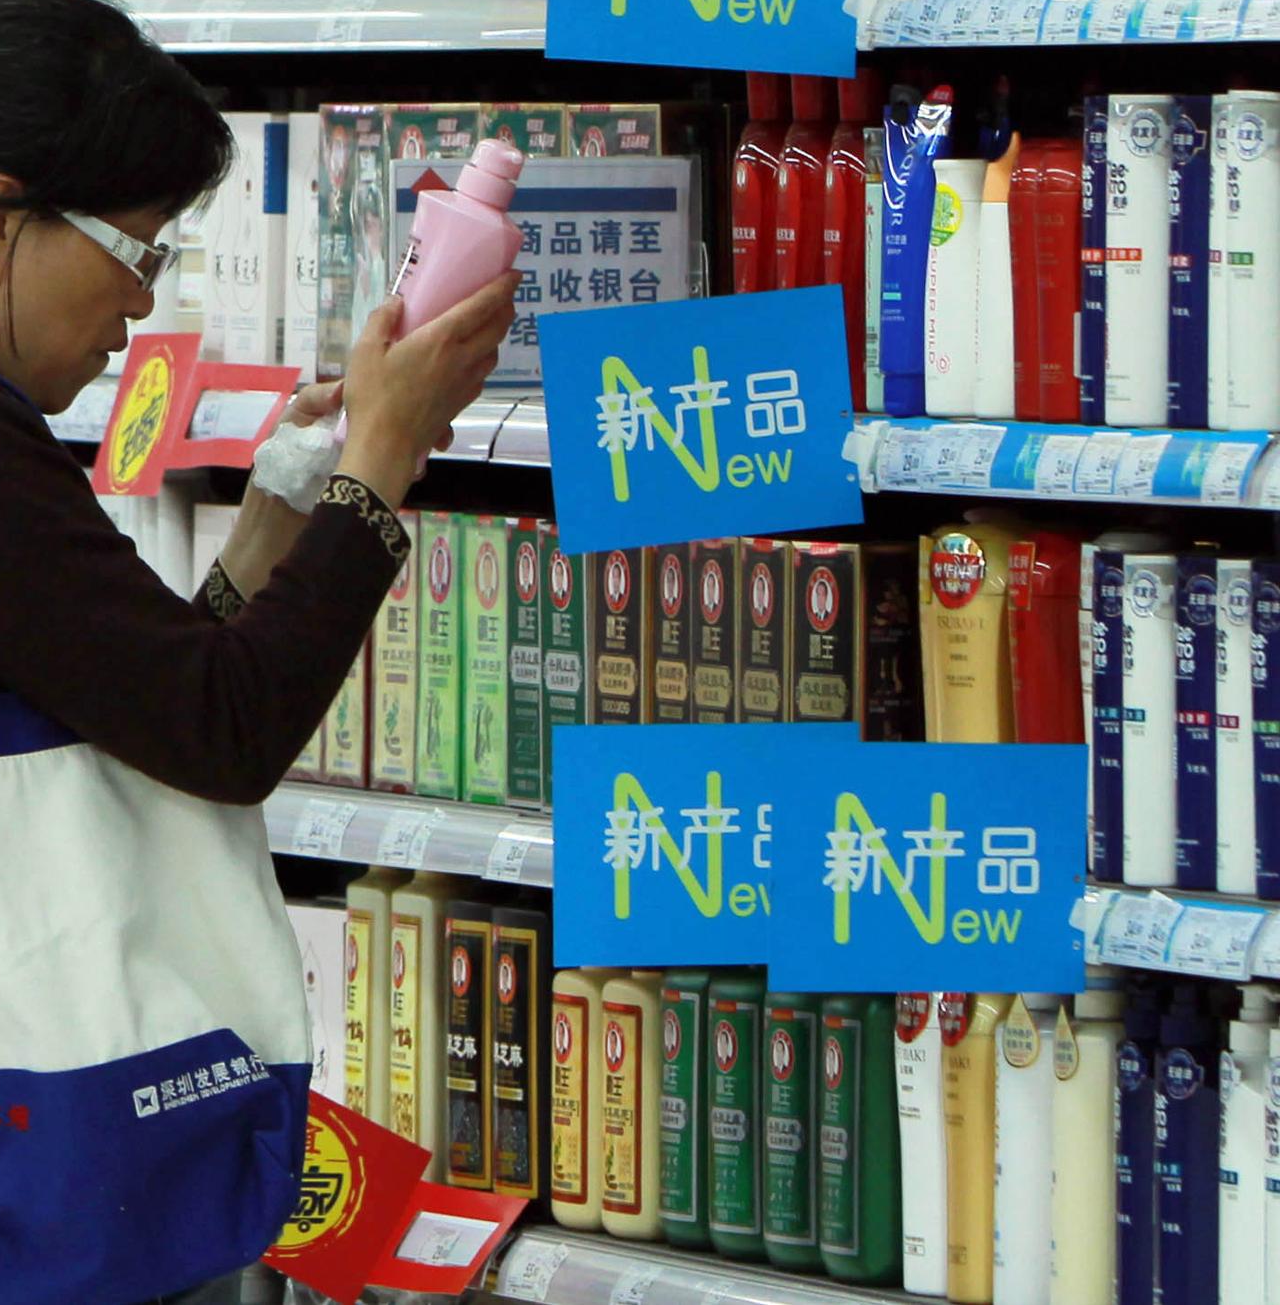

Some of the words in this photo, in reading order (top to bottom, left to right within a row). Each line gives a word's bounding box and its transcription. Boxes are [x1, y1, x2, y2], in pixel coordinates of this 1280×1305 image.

[596, 369, 807, 454] 新产品
[600, 346, 792, 503] New
[825, 826, 1040, 895] 新产品
[834, 792, 1022, 944] New
[159, 1053, 266, 1100] 深圳发展银行
